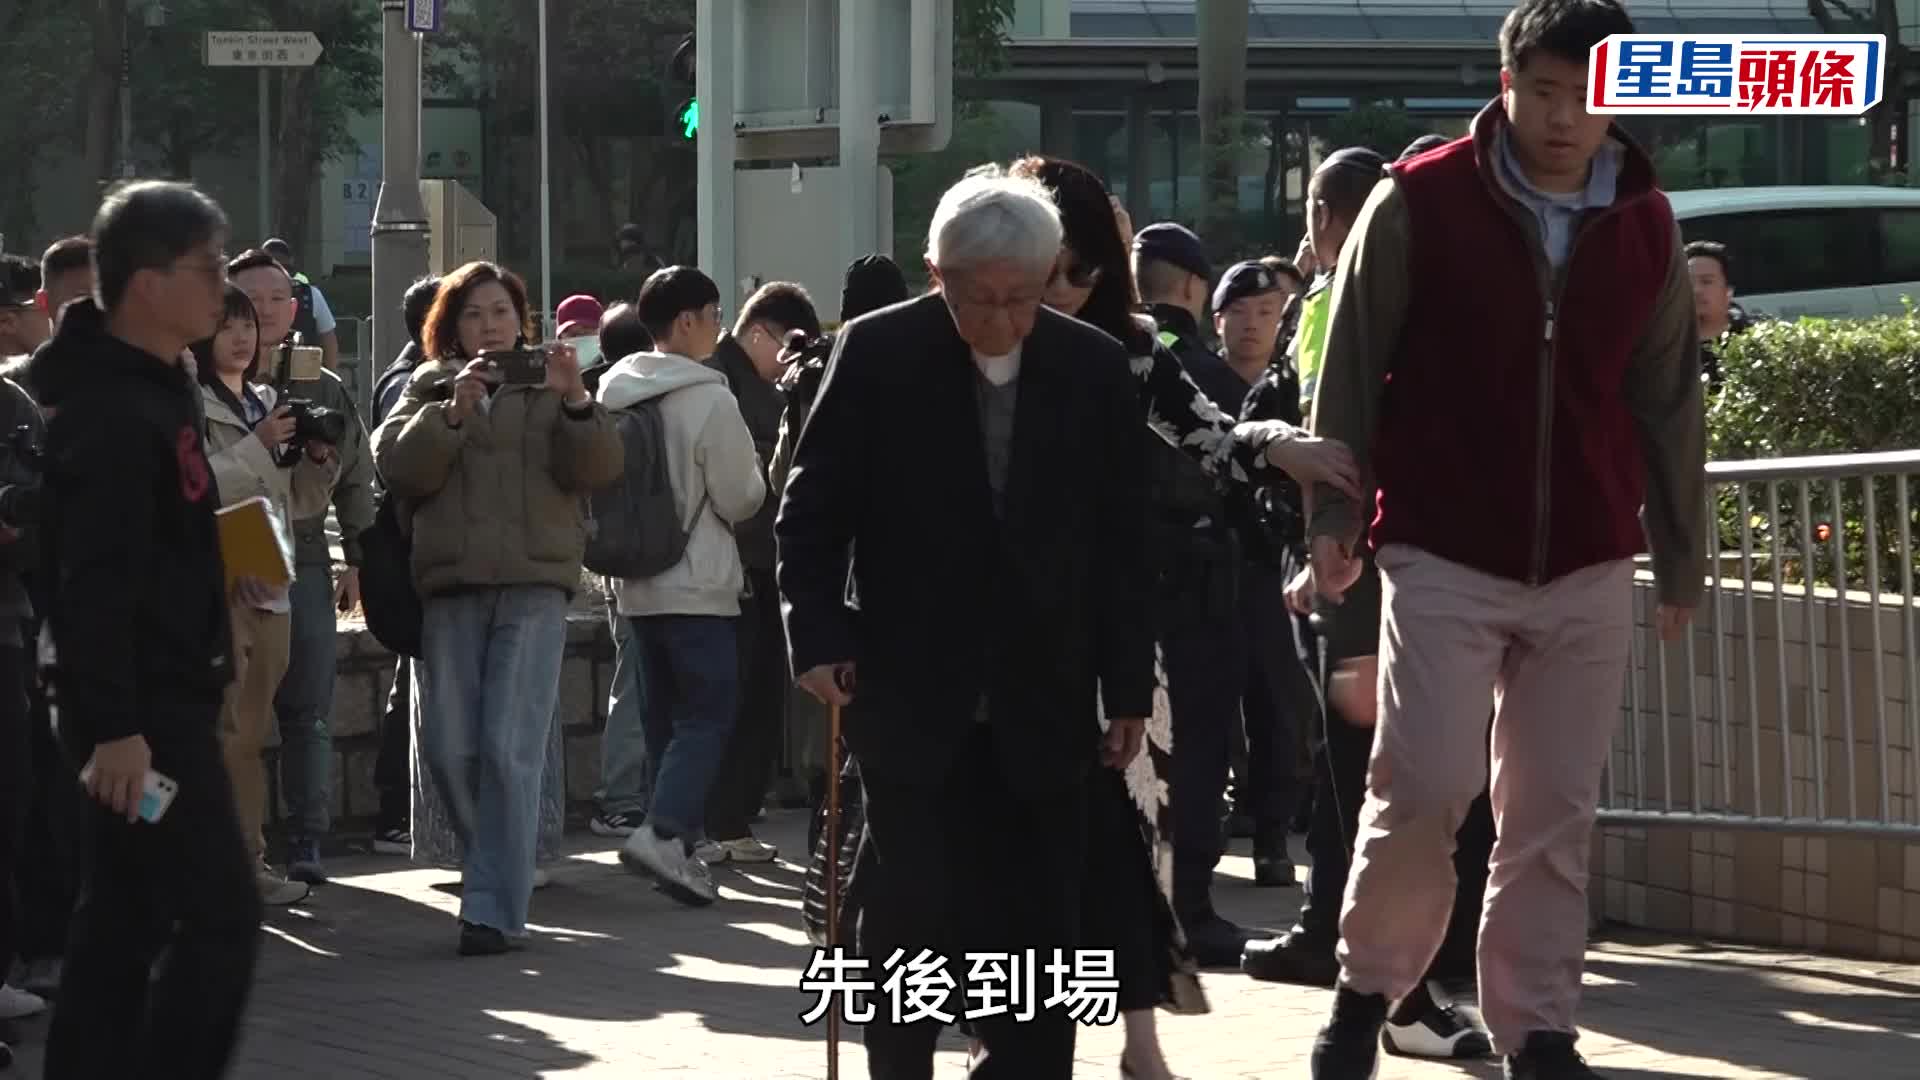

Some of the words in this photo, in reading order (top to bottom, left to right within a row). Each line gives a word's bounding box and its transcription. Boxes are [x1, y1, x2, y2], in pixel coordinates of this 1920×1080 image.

[247, 34, 280, 45] Street
[231, 48, 289, 61] 東街西
